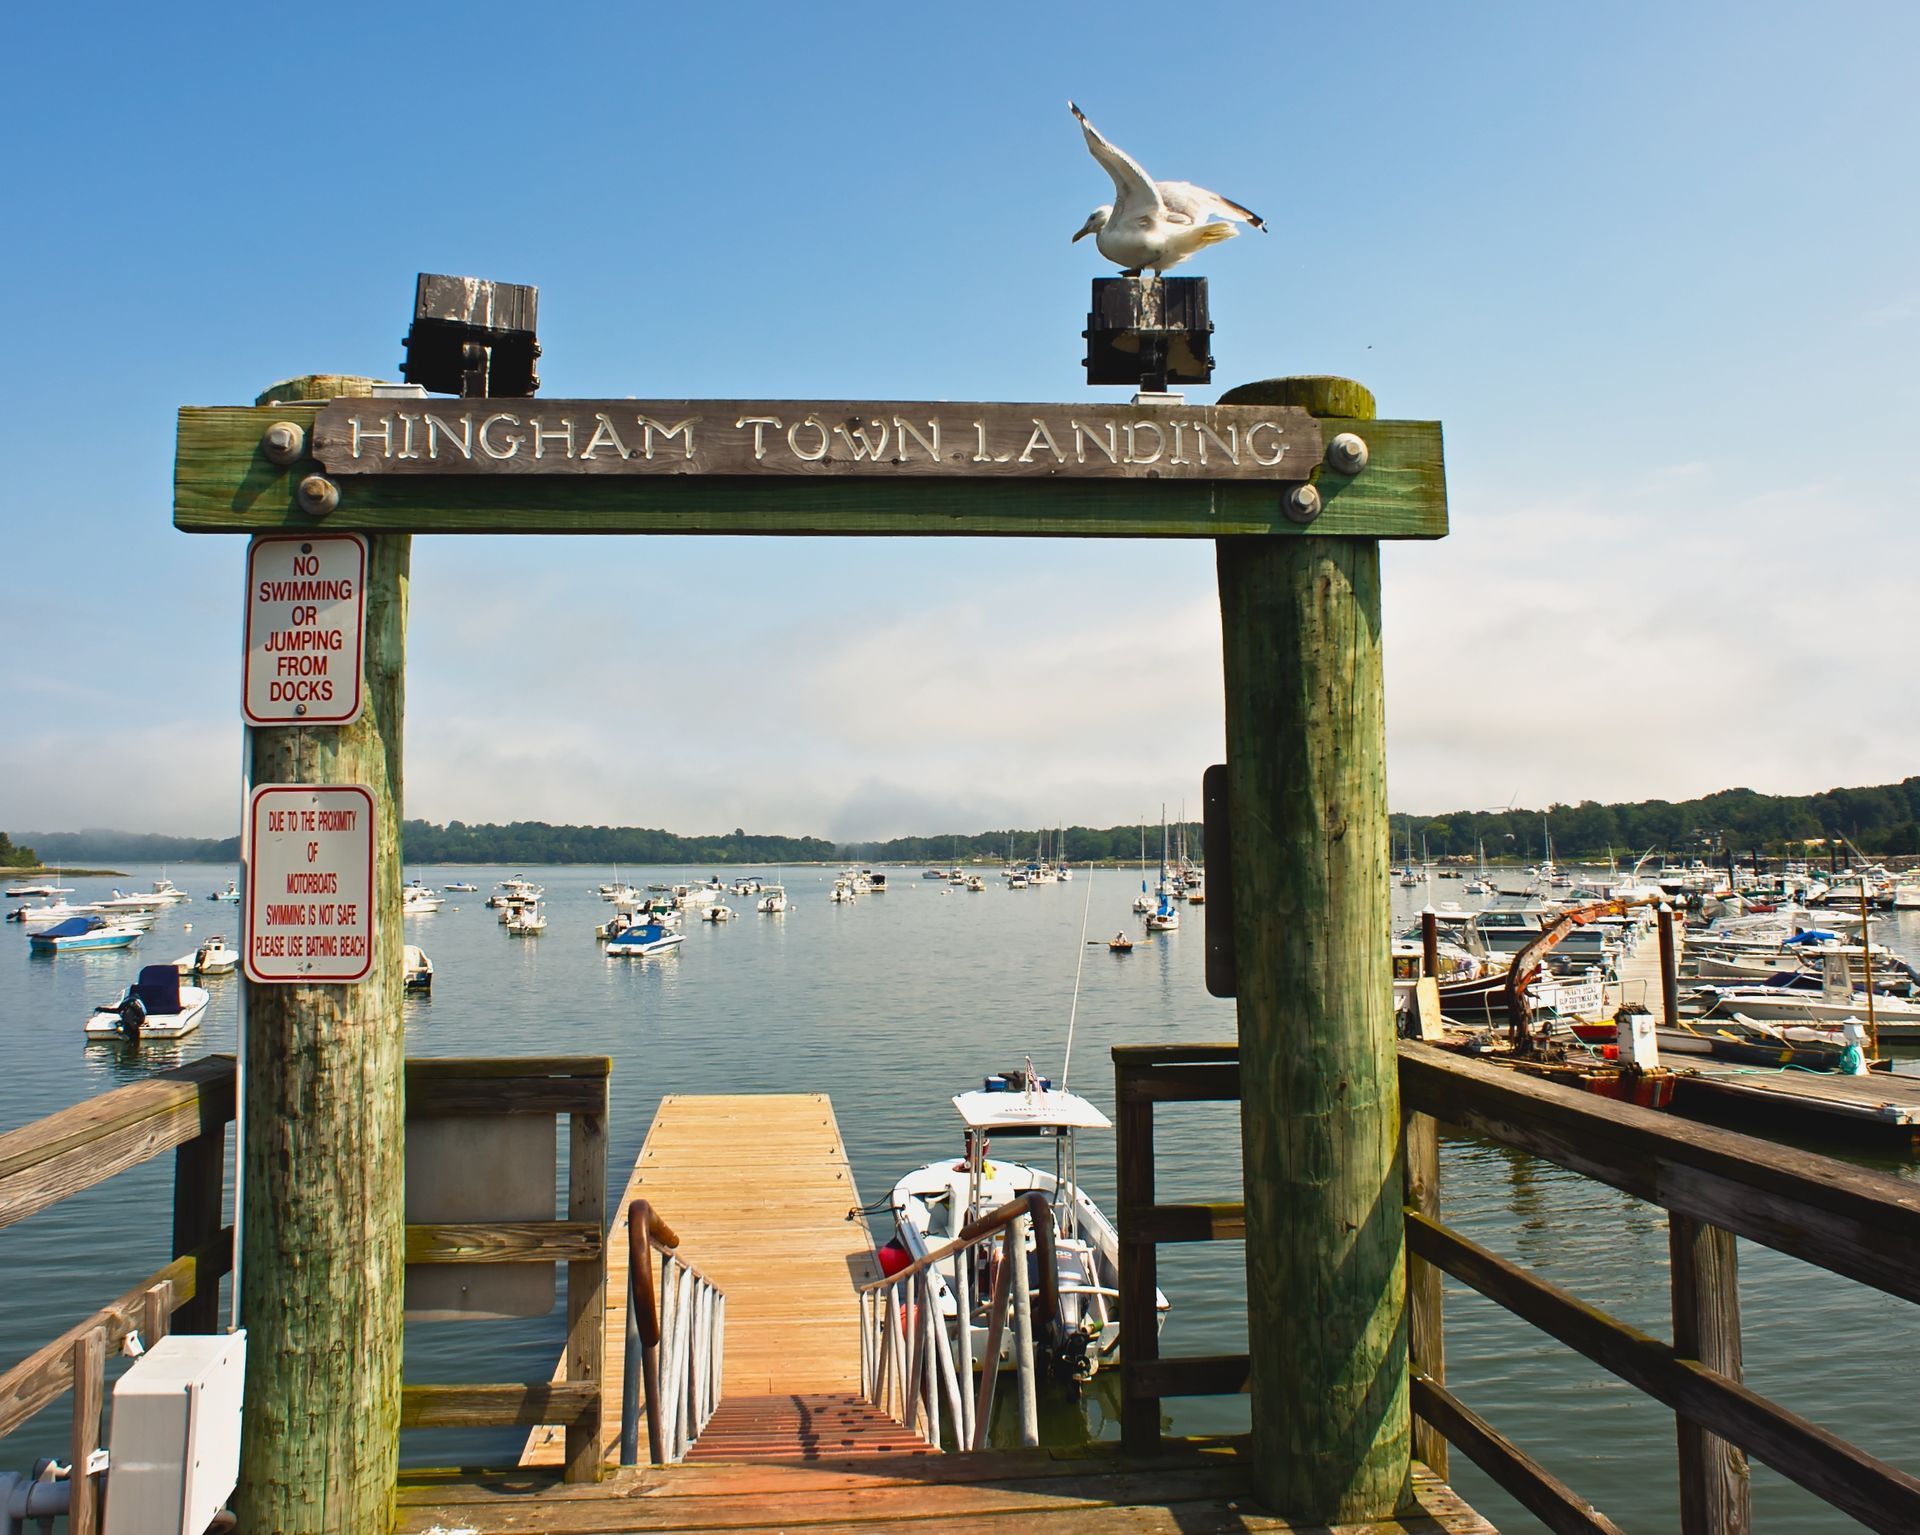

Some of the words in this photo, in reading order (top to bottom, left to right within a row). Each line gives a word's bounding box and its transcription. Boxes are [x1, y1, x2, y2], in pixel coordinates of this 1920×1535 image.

[348, 412, 703, 460] HINGHAM
[736, 414, 942, 463] TOWN
[973, 418, 1292, 467] LANDING
[293, 556, 319, 576] NO
[259, 580, 352, 602] SWIMMING
[292, 606, 317, 626] OR
[265, 630, 342, 652] JUMPING
[277, 656, 327, 676] FROM
[270, 680, 333, 702] DOCKS
[269, 811, 284, 832] DUE
[288, 811, 298, 831] TO
[301, 811, 316, 831] THE
[318, 810, 357, 831] PROXIMITY
[308, 842, 318, 863] OF
[287, 873, 337, 894] MOTORBOATS
[266, 904, 306, 926] SWIMMING
[308, 904, 316, 925] IS
[319, 904, 335, 925] NOT
[337, 904, 357, 925] SAFE
[256, 936, 285, 957] PLEASE
[287, 936, 303, 957] USE
[306, 936, 337, 957] BATHING
[340, 936, 366, 957] BEACH
